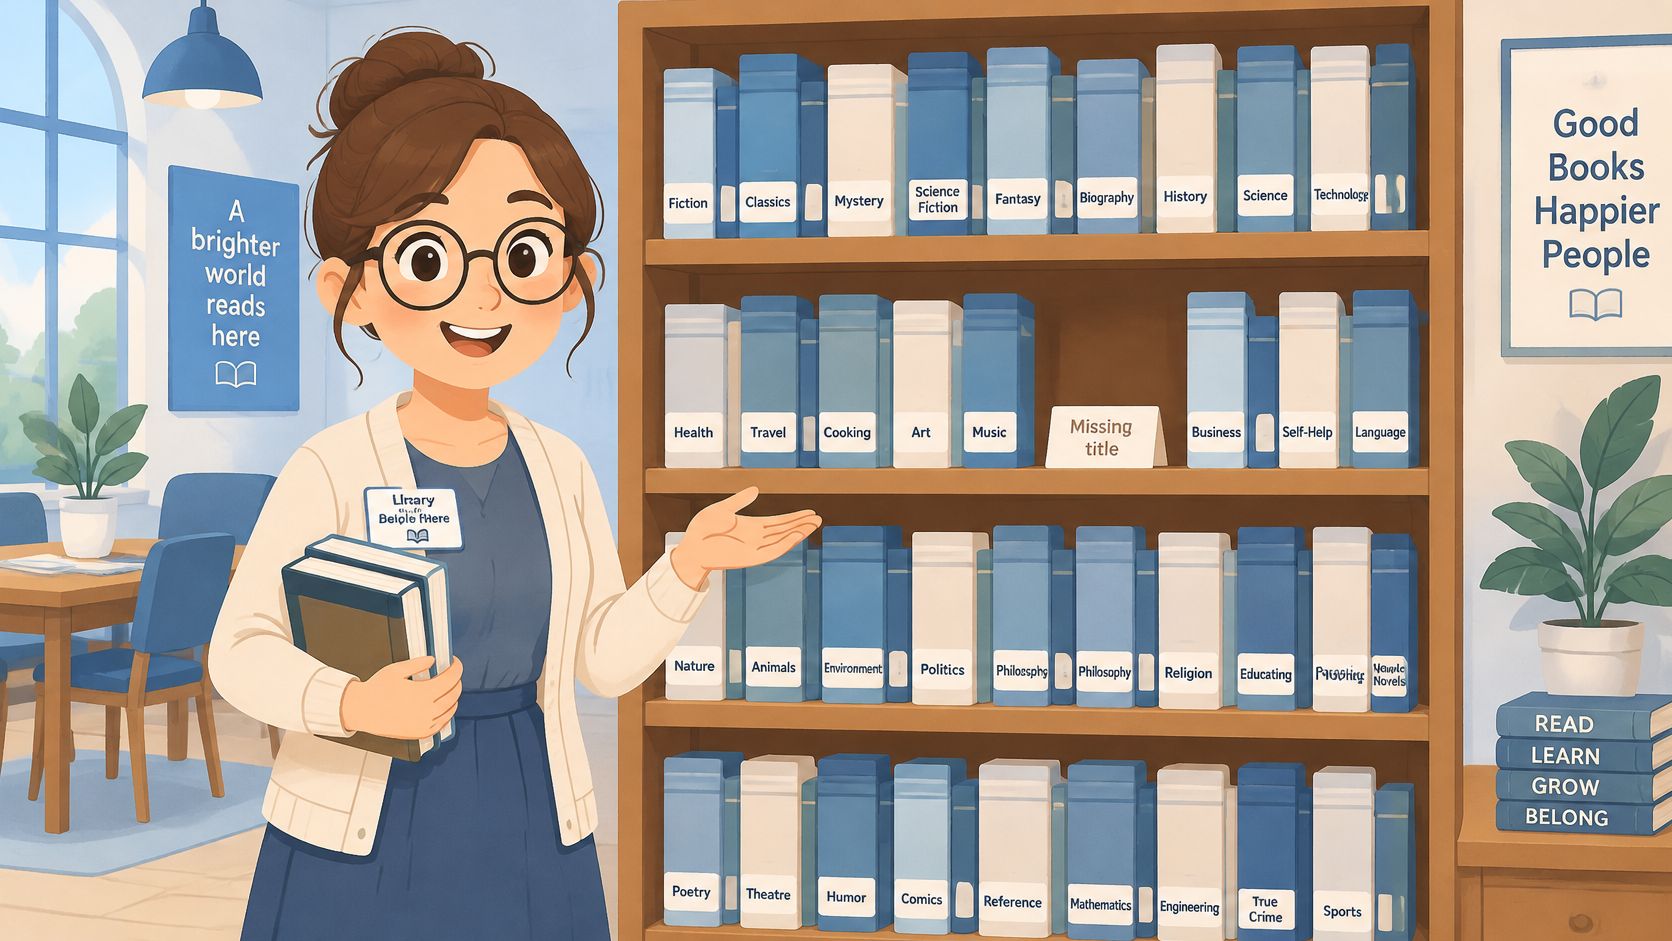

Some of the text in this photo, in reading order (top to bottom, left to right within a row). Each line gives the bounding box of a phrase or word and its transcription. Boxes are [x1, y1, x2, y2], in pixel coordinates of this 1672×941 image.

[1554, 107, 1638, 138] Good
[1550, 151, 1644, 181] Books
[916, 186, 959, 197] Science
[1081, 191, 1134, 205] Biography
[1165, 191, 1207, 204] History
[1244, 190, 1287, 201] Science
[669, 198, 707, 208] Fiction
[746, 196, 790, 207] Classics
[835, 195, 884, 208] Mystery
[996, 193, 1041, 206] Fantasy
[229, 200, 244, 222] A
[919, 201, 958, 213] Fiction
[1536, 195, 1660, 232] Happier
[192, 227, 280, 259] brighter
[1544, 239, 1650, 275] People
[205, 263, 265, 286] world
[208, 294, 265, 316] reads
[213, 323, 259, 346] here
[675, 427, 713, 437] Health
[751, 427, 785, 438] Travel
[824, 427, 870, 440] Cooking
[912, 427, 931, 437] Art
[973, 427, 1006, 437] Music
[1071, 419, 1132, 437] Missing
[1193, 427, 1241, 437] Business
[1283, 426, 1332, 440] Self-Help
[1356, 427, 1406, 440] Language
[1086, 441, 1118, 456] title
[675, 661, 714, 671] Nature
[752, 662, 795, 672] Animals
[825, 663, 882, 673] Environment
[921, 664, 964, 675] Politics
[1079, 666, 1131, 680] Philosophy
[1166, 667, 1212, 681] Religion
[1241, 668, 1292, 683] Educating
[1374, 676, 1406, 686] Novels
[1536, 715, 1593, 732] READ
[1532, 747, 1599, 764] LEARN
[1532, 777, 1599, 795] GROW
[1526, 808, 1608, 826] BELONG
[673, 886, 710, 900] Poetry
[746, 888, 790, 900] Theatre
[827, 891, 866, 902] Humor
[902, 893, 942, 905] Comics
[984, 896, 1042, 908] Reference
[1070, 897, 1132, 911] Mathematics
[1253, 896, 1277, 907] True
[1161, 901, 1219, 916] Engineering
[1324, 905, 1361, 919] Sports
[1249, 911, 1282, 922] Crime
